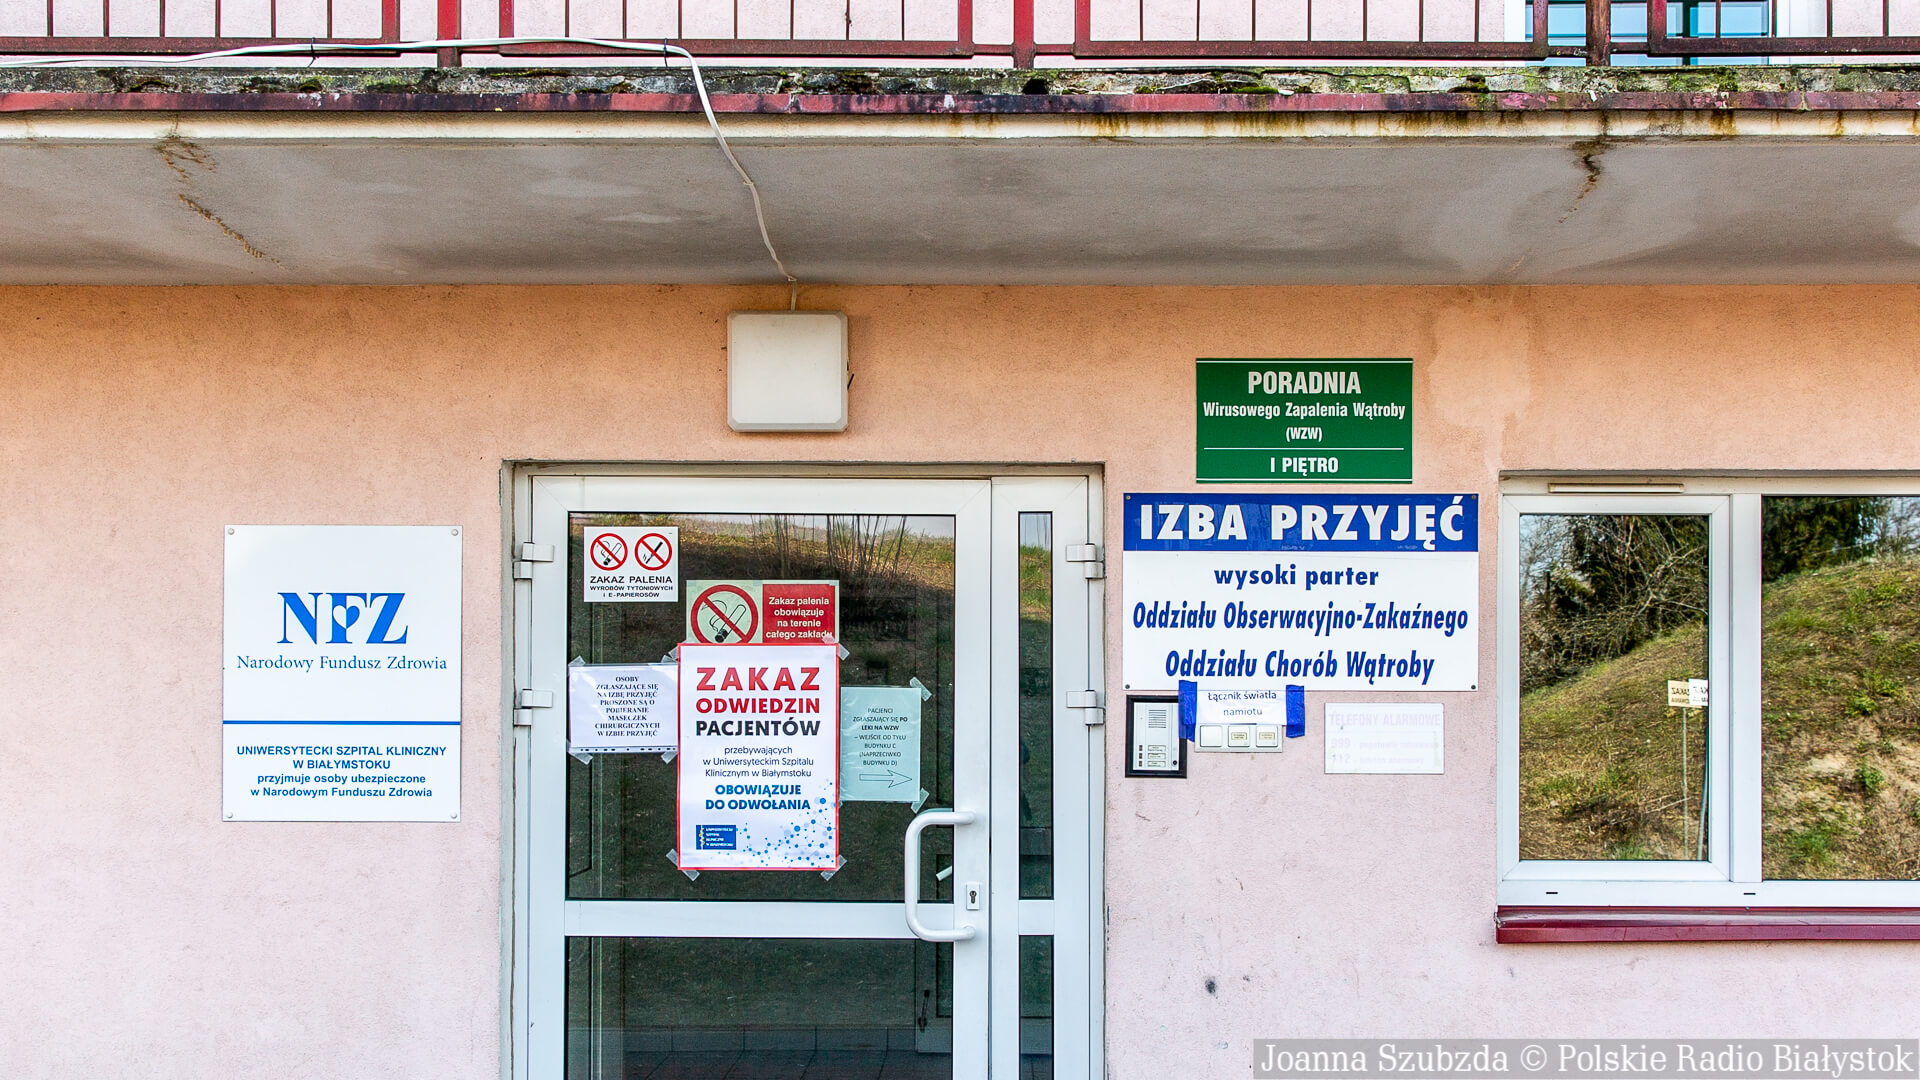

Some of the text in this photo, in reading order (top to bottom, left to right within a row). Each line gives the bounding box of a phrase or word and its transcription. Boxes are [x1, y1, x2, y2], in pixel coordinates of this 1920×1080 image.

[1248, 371, 1361, 394] PORADNIA
[1203, 402, 1405, 420] Wirusowego Zapalenia Wątroby
[1286, 427, 1322, 442] (WZW)
[1271, 457, 1338, 476] I PIĘTRO
[1139, 496, 1463, 550] IZBA PRZYJĘĆ
[1214, 564, 1378, 590] wysoki parter
[797, 597, 829, 606] palenia
[277, 592, 408, 644] NFZ
[774, 608, 824, 617] obowiązuje
[791, 619, 821, 627] terenie
[1133, 601, 1468, 637] Oddziału Obserwacyjno-Zakaźnego
[766, 630, 795, 639] całego
[238, 655, 446, 672] Narodowy Fundusz Zdrowia
[1166, 649, 1434, 685] Oddziału Chorób Wątroby
[697, 667, 819, 691] ZAKAZ
[1207, 692, 1241, 702] Łącznik
[696, 698, 819, 713] ODWIEDZIN
[1329, 713, 1440, 726] TELEFONY ALARMOWE
[696, 717, 820, 736] PACJENTÓW
[237, 746, 446, 755] UNIWERSYTECKI SZPITAL KLINICZNY
[725, 746, 792, 755] przebywających
[293, 760, 390, 769] W BIAŁYMSTOKU
[713, 758, 779, 767] Uniwersyteckim
[782, 758, 813, 766] Szpitalu
[258, 774, 425, 784] przyjmuje osoby ubezpieczone
[706, 769, 749, 778] Klinicznym
[762, 769, 811, 778] Białymstoku
[263, 787, 327, 797] Narodowym
[332, 788, 385, 796] Funduszu
[389, 788, 432, 796] Zdrowia
[715, 785, 801, 797] OBOWIĄZUJE
[706, 800, 810, 809] DO ODWOŁANIA
